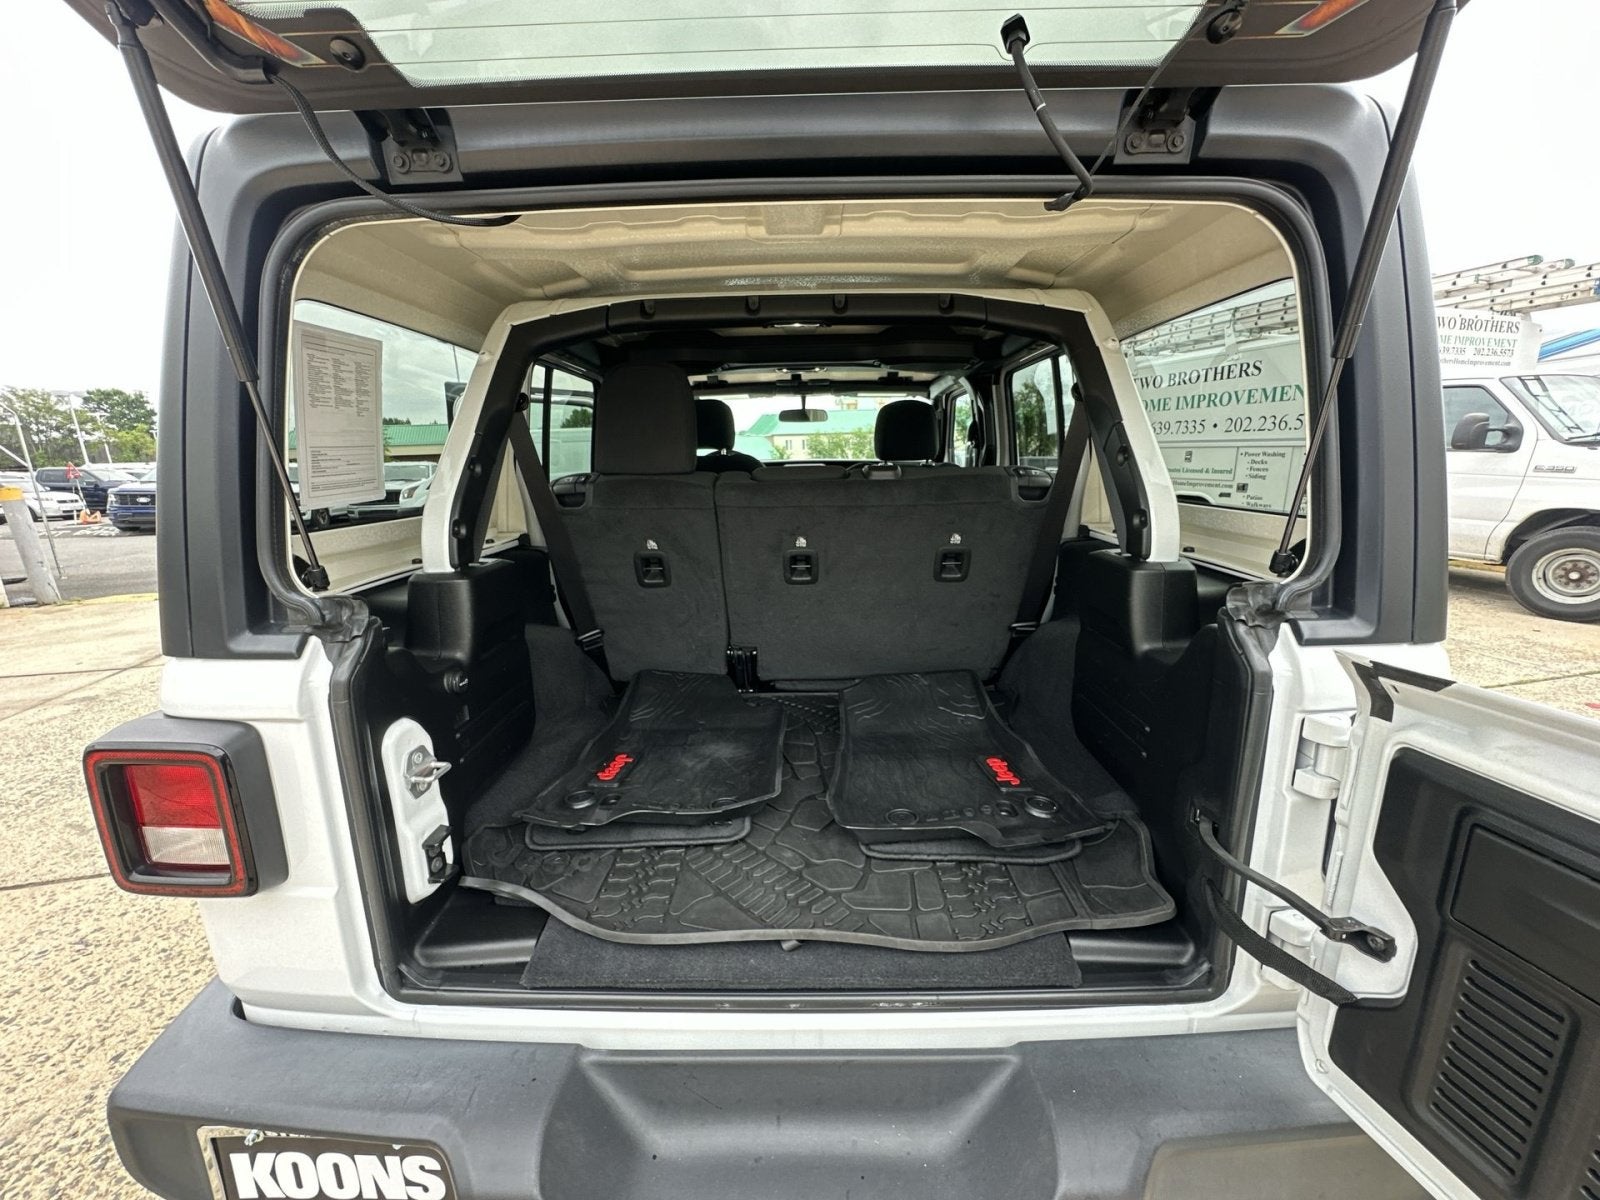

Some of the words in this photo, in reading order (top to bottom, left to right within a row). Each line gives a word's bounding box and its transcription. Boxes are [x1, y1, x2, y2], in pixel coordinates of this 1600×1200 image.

[1459, 317, 1521, 334] BROTHERS
[1440, 346, 1466, 356] 39.7335
[1454, 335, 1518, 349] IMPROVEMENT
[1168, 360, 1263, 388] BROTHERS
[1175, 384, 1304, 410] IMPROVEMEN
[1224, 413, 1304, 432] 202.236.5
[229, 1151, 446, 1200] KOONS
